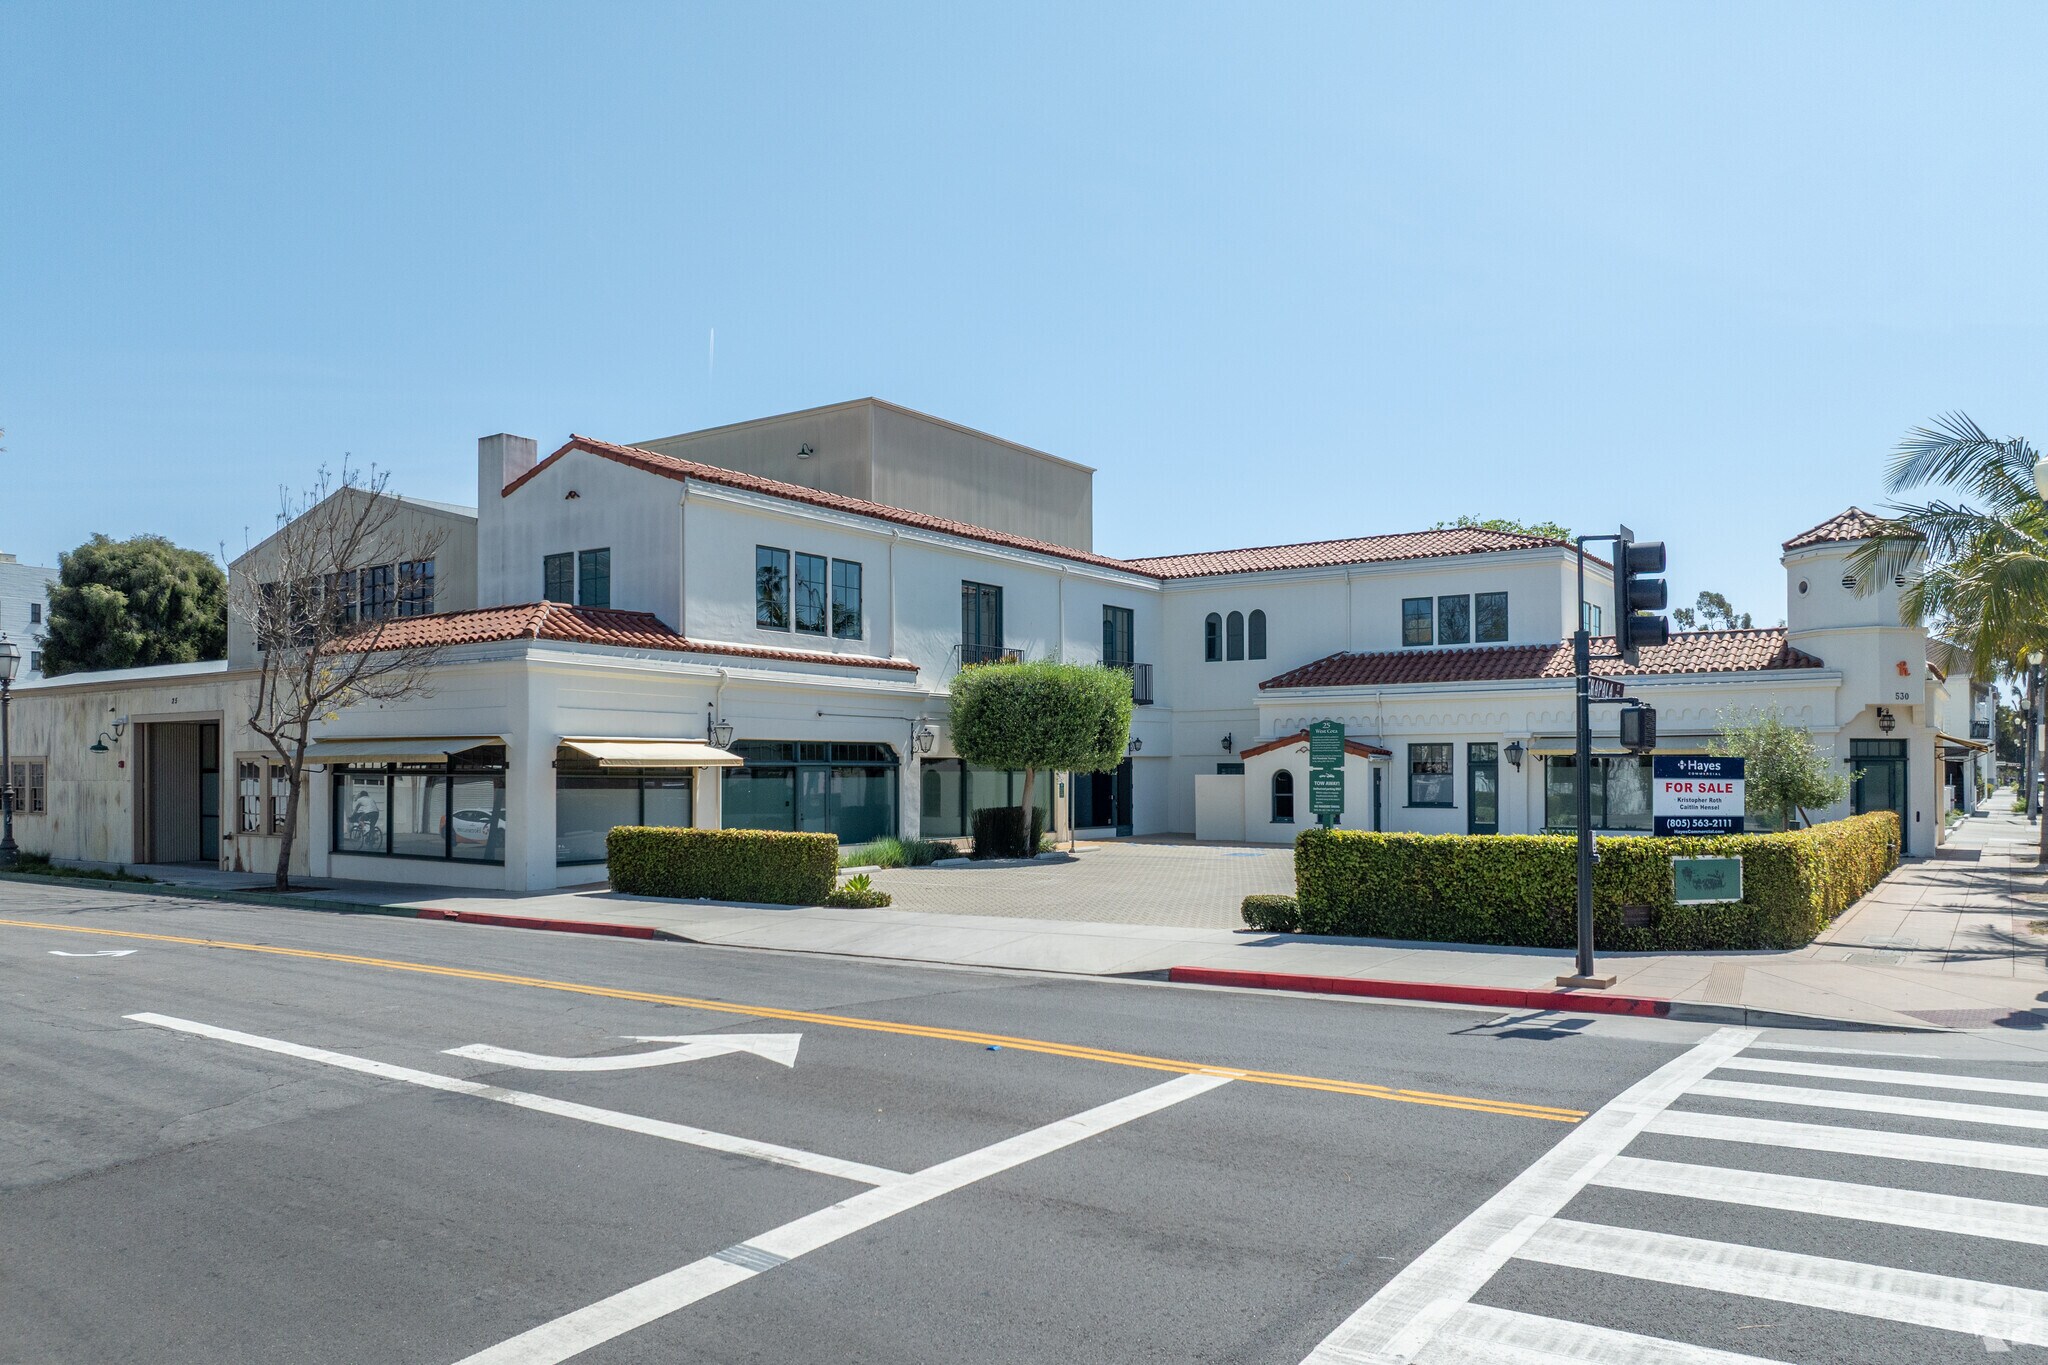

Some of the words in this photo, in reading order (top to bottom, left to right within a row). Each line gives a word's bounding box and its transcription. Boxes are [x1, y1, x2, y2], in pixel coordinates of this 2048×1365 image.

[1895, 692, 1909, 700] 530
[1688, 760, 1721, 772] Hayes
[1665, 782, 1693, 793] FOR
[1698, 783, 1733, 793] SALE
[1666, 818, 1691, 829] (805)
[1692, 819, 1732, 827] 563-2111
